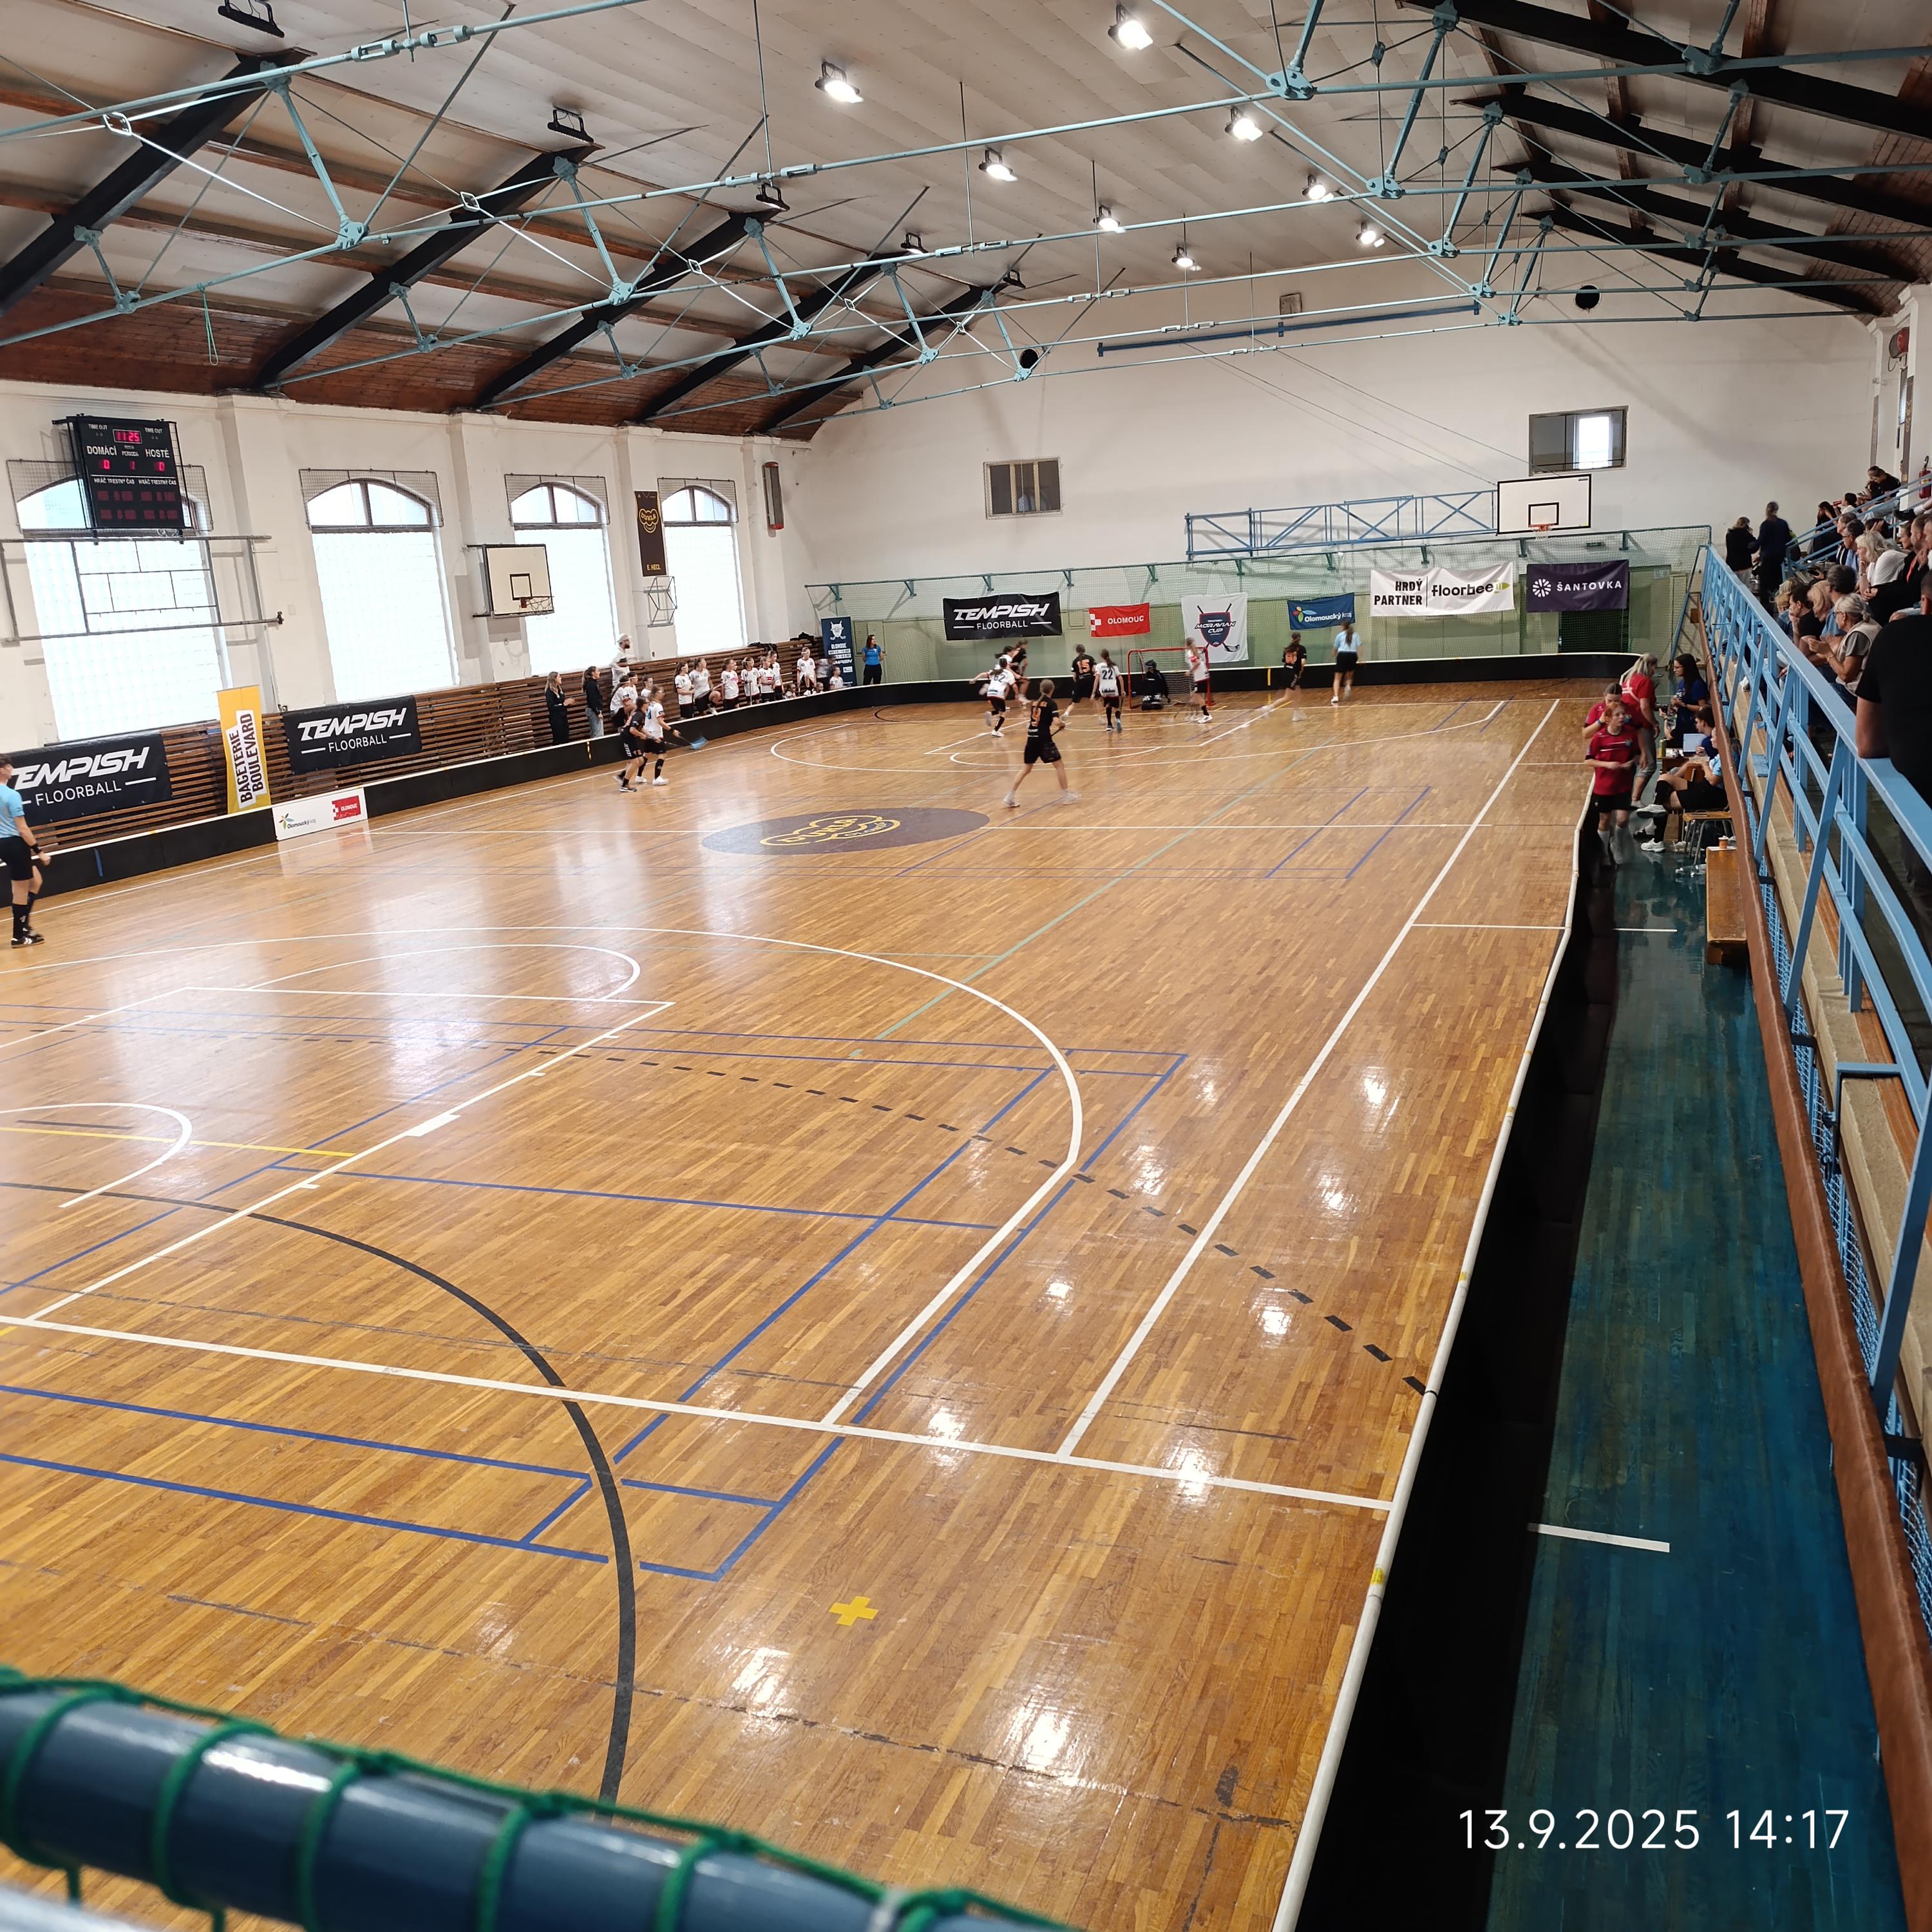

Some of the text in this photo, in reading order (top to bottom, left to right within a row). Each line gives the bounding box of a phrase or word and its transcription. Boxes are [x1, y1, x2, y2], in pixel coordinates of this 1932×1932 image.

[86, 445, 117, 455] DOMÁCÍ
[145, 448, 170, 458] HOSTÉ
[1395, 578, 1423, 591] HRDÝ
[1432, 583, 1493, 596] floorbee
[1557, 580, 1622, 592] ŠANTOVKA
[1374, 595, 1423, 605] PARTNER
[953, 603, 1050, 621] TEMPISH
[1304, 612, 1341, 622] Olomoucký
[976, 620, 1028, 630] FLOORBALL
[1108, 615, 1144, 624] OLOMOUC
[1077, 659, 1090, 674] 15
[1102, 670, 1113, 679] 22
[297, 708, 407, 741] TEMPISH
[328, 734, 387, 753] FLOORBALL
[240, 713, 264, 793] BOULEVARD
[12, 746, 149, 790] EMPISH
[229, 730, 253, 803] BAGETERIE
[35, 781, 122, 806] FLOORBALL
